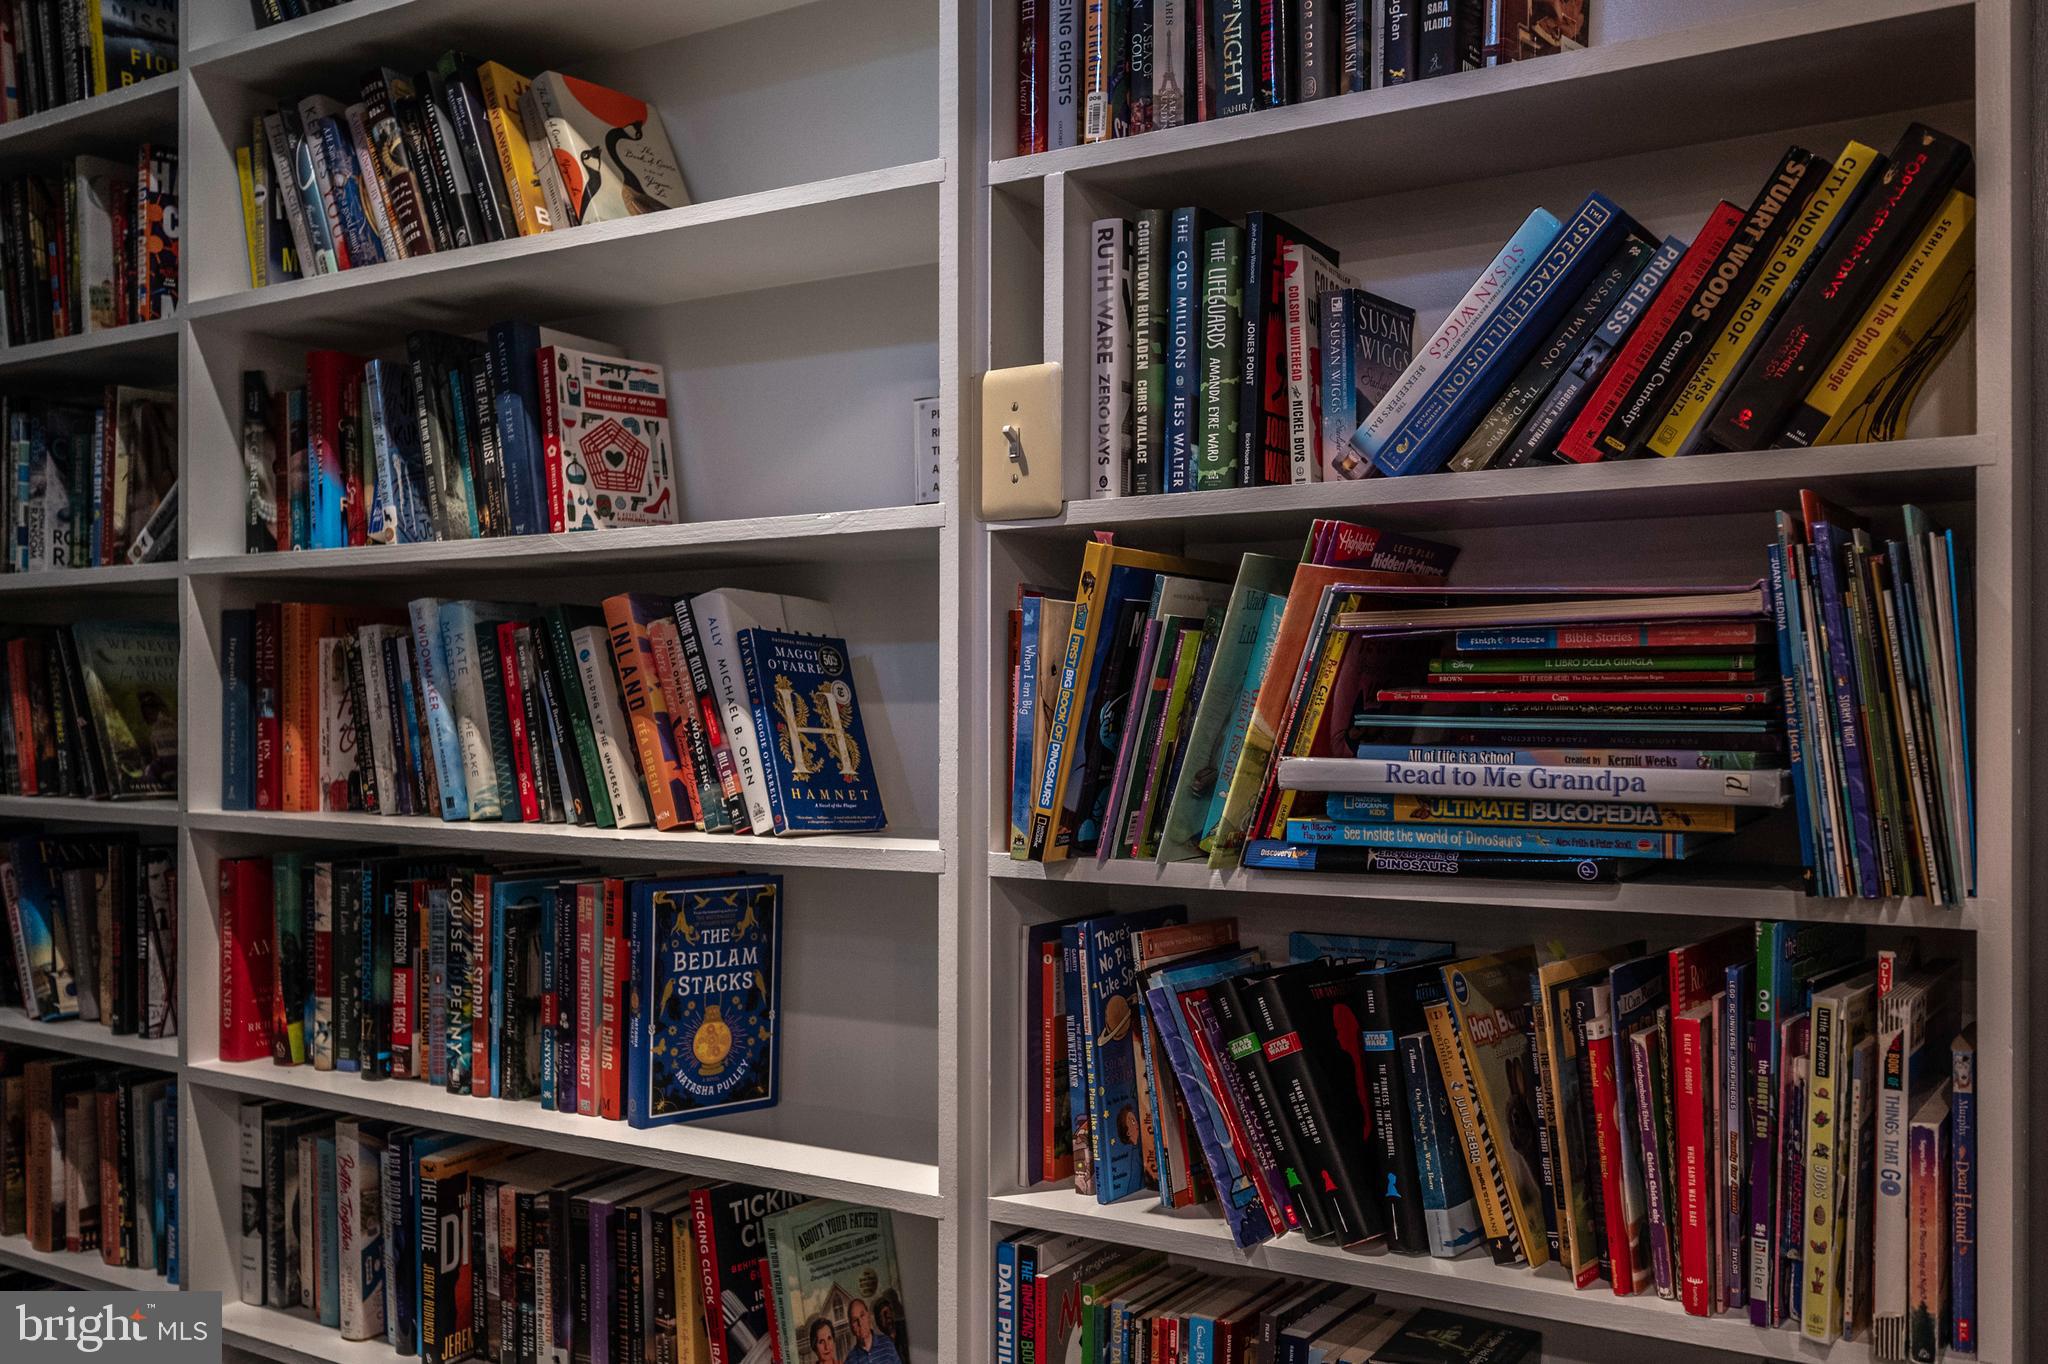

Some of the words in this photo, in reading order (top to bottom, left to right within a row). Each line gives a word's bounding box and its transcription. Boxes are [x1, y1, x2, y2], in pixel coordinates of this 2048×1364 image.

[1423, 16, 1451, 31] VLADIC
[1131, 34, 1142, 72] GOLD
[1222, 12, 1243, 95] NIGHT
[1304, 24, 1313, 68] TOBAR
[1059, 41, 1071, 105] GHOSTS
[1222, 104, 1248, 115] TAHIR
[496, 122, 512, 173] LAWSON
[511, 178, 525, 220] BROKEN
[1825, 157, 1857, 198] CITY
[1745, 160, 1806, 241] STUART
[1177, 216, 1188, 242] THE
[1781, 198, 1831, 259] UNDER
[1922, 219, 1952, 256] SERHIY
[1097, 228, 1113, 291] RUTH
[1137, 220, 1150, 301] COUNTDOWN
[1176, 251, 1187, 290] COLD
[1211, 240, 1225, 263] THE
[1520, 223, 1590, 311] SPECTACLE
[1474, 244, 1523, 301] SUSAN
[1584, 268, 1622, 315] SUSAN
[1605, 245, 1679, 334] PRICELESS
[1692, 243, 1756, 320] WOODS
[1756, 261, 1788, 297] ONE
[1892, 262, 1927, 300] ZHADAN
[1137, 304, 1150, 326] BIN
[1206, 268, 1227, 350] LIFEGUARDS
[1289, 286, 1299, 323] COLSON
[1728, 300, 1762, 344] ROOF
[1874, 303, 1898, 326] The
[1097, 298, 1112, 364] WARE
[1175, 298, 1186, 369] MILLIONS
[1246, 321, 1255, 353] JONES
[1330, 320, 1340, 365] SUSAN
[1360, 306, 1411, 346] SUSAN
[1429, 306, 1477, 360] WIGGS
[1541, 315, 1587, 369] WILSON
[1137, 329, 1149, 370] LADEN
[1290, 326, 1303, 381] WHITEHEAD
[1360, 334, 1410, 371] WIGGS
[1441, 325, 1507, 400] ILLUSION
[1663, 331, 1693, 382] Carnal
[1829, 325, 1881, 392] Orphanage
[1208, 358, 1220, 404] AMANDA
[1245, 355, 1255, 386] POINT
[1670, 351, 1720, 418] YAMASHITA
[1695, 378, 1716, 402] IRIS
[587, 391, 602, 401] THE
[602, 394, 628, 404] HEART
[639, 398, 657, 407] WAR
[1097, 375, 1111, 418] ZERO
[1136, 380, 1148, 416] CHRIS
[1332, 371, 1341, 413] WIGGS
[1624, 373, 1667, 429] Curiosity
[1173, 396, 1184, 431] JESS
[1208, 407, 1220, 432] EYRE
[1293, 400, 1305, 435] NICKEL
[1097, 423, 1110, 465] DAYS
[1136, 418, 1147, 464] WALLACE
[1207, 434, 1219, 462] WARD
[1294, 438, 1305, 463] BOYS
[1173, 436, 1184, 488] WALTER
[1340, 529, 1375, 555] Highlights
[1371, 552, 1403, 571] Hidden
[674, 601, 692, 635] KILLING
[684, 636, 697, 655] THE
[775, 646, 818, 659] MAGGI
[1070, 635, 1085, 668] FIRST
[1564, 632, 1595, 644] Bible
[1597, 632, 1633, 643] Stories
[419, 623, 440, 711] WIDOWMAKER
[689, 653, 708, 692] KILLERS
[767, 658, 825, 674] O'FARRE
[1063, 670, 1075, 689] BIG
[1544, 658, 1554, 667] IL
[1554, 658, 1581, 667] LIBRO
[1583, 658, 1611, 667] DELLA
[1613, 657, 1653, 667] GIUNGLA
[611, 622, 645, 712] INLAND
[644, 747, 660, 795] OBREHT
[708, 617, 722, 647] ALLY
[718, 659, 740, 722] MICHAEL
[734, 726, 743, 740] B.
[739, 746, 755, 786] OREN
[1056, 693, 1072, 725] BOOK
[1551, 693, 1569, 702] Cars
[742, 637, 757, 695] HAMNET
[755, 709, 768, 749] MAGGIE
[763, 751, 777, 807] O'FARRELL
[1052, 727, 1063, 742] OF
[717, 751, 727, 770] BILL
[722, 769, 738, 802] O'REILLY
[1040, 743, 1059, 806] DINOSAURS
[1385, 763, 1446, 785] Read
[1452, 766, 1476, 785] to
[1482, 767, 1521, 787] Me
[1528, 767, 1647, 797] Grandpa
[1608, 754, 1643, 767] Kermit
[1646, 755, 1677, 767] Weeks
[792, 788, 868, 801] HAMNET
[1429, 799, 1525, 819] ULTIMATE
[1530, 802, 1660, 824] BUGOPEDIA
[1343, 826, 1361, 840] See
[1394, 828, 1413, 841] the
[1415, 829, 1447, 843] world
[1449, 830, 1464, 845] of
[1466, 831, 1522, 847] Dinosaurs
[1375, 860, 1459, 873] DINOSAURS
[451, 878, 462, 953] LOUISE
[474, 893, 485, 928] INTO
[223, 909, 232, 985] AMERICAN
[473, 932, 484, 963] THE
[580, 932, 591, 954] THE
[701, 928, 731, 945] THE
[603, 936, 616, 998] THRIVING
[672, 946, 758, 973] BEDLAM
[472, 965, 484, 1019] STORM
[580, 959, 591, 1035] AUTHENTICITY
[677, 971, 753, 996] STACKS
[223, 987, 232, 1029] NERO
[451, 984, 463, 1058] PENNY
[603, 1000, 615, 1021] ON
[1817, 1008, 1830, 1031] Little
[580, 1040, 591, 1089] PROJECT
[602, 1024, 614, 1072] CHAOS
[1816, 1032, 1828, 1078] Explorers
[675, 1069, 714, 1095] NATASHA
[716, 1058, 750, 1094] PULLEY
[1453, 1096, 1473, 1132] JULIUS
[1886, 1096, 1900, 1134] THINGS
[1462, 1132, 1480, 1165] ZEBRA
[1884, 1139, 1899, 1166] THAT
[339, 1153, 356, 1196] Better
[420, 1177, 437, 1201] THE
[1815, 1165, 1827, 1199] BUGS
[1881, 1168, 1902, 1196] GO
[167, 1224, 175, 1259] AGAIN
[338, 1197, 355, 1252] Together
[421, 1204, 437, 1253] DIVIDE
[798, 1226, 825, 1250] ABOUT
[826, 1218, 848, 1235] YOUR
[849, 1211, 878, 1229] FATHER
[695, 1197, 709, 1256] TICKING
[702, 1258, 716, 1306] CLOCK
[423, 1263, 436, 1300] JEREMY
[998, 1264, 1012, 1311] DAN
[423, 1300, 436, 1345] ROBINSON
